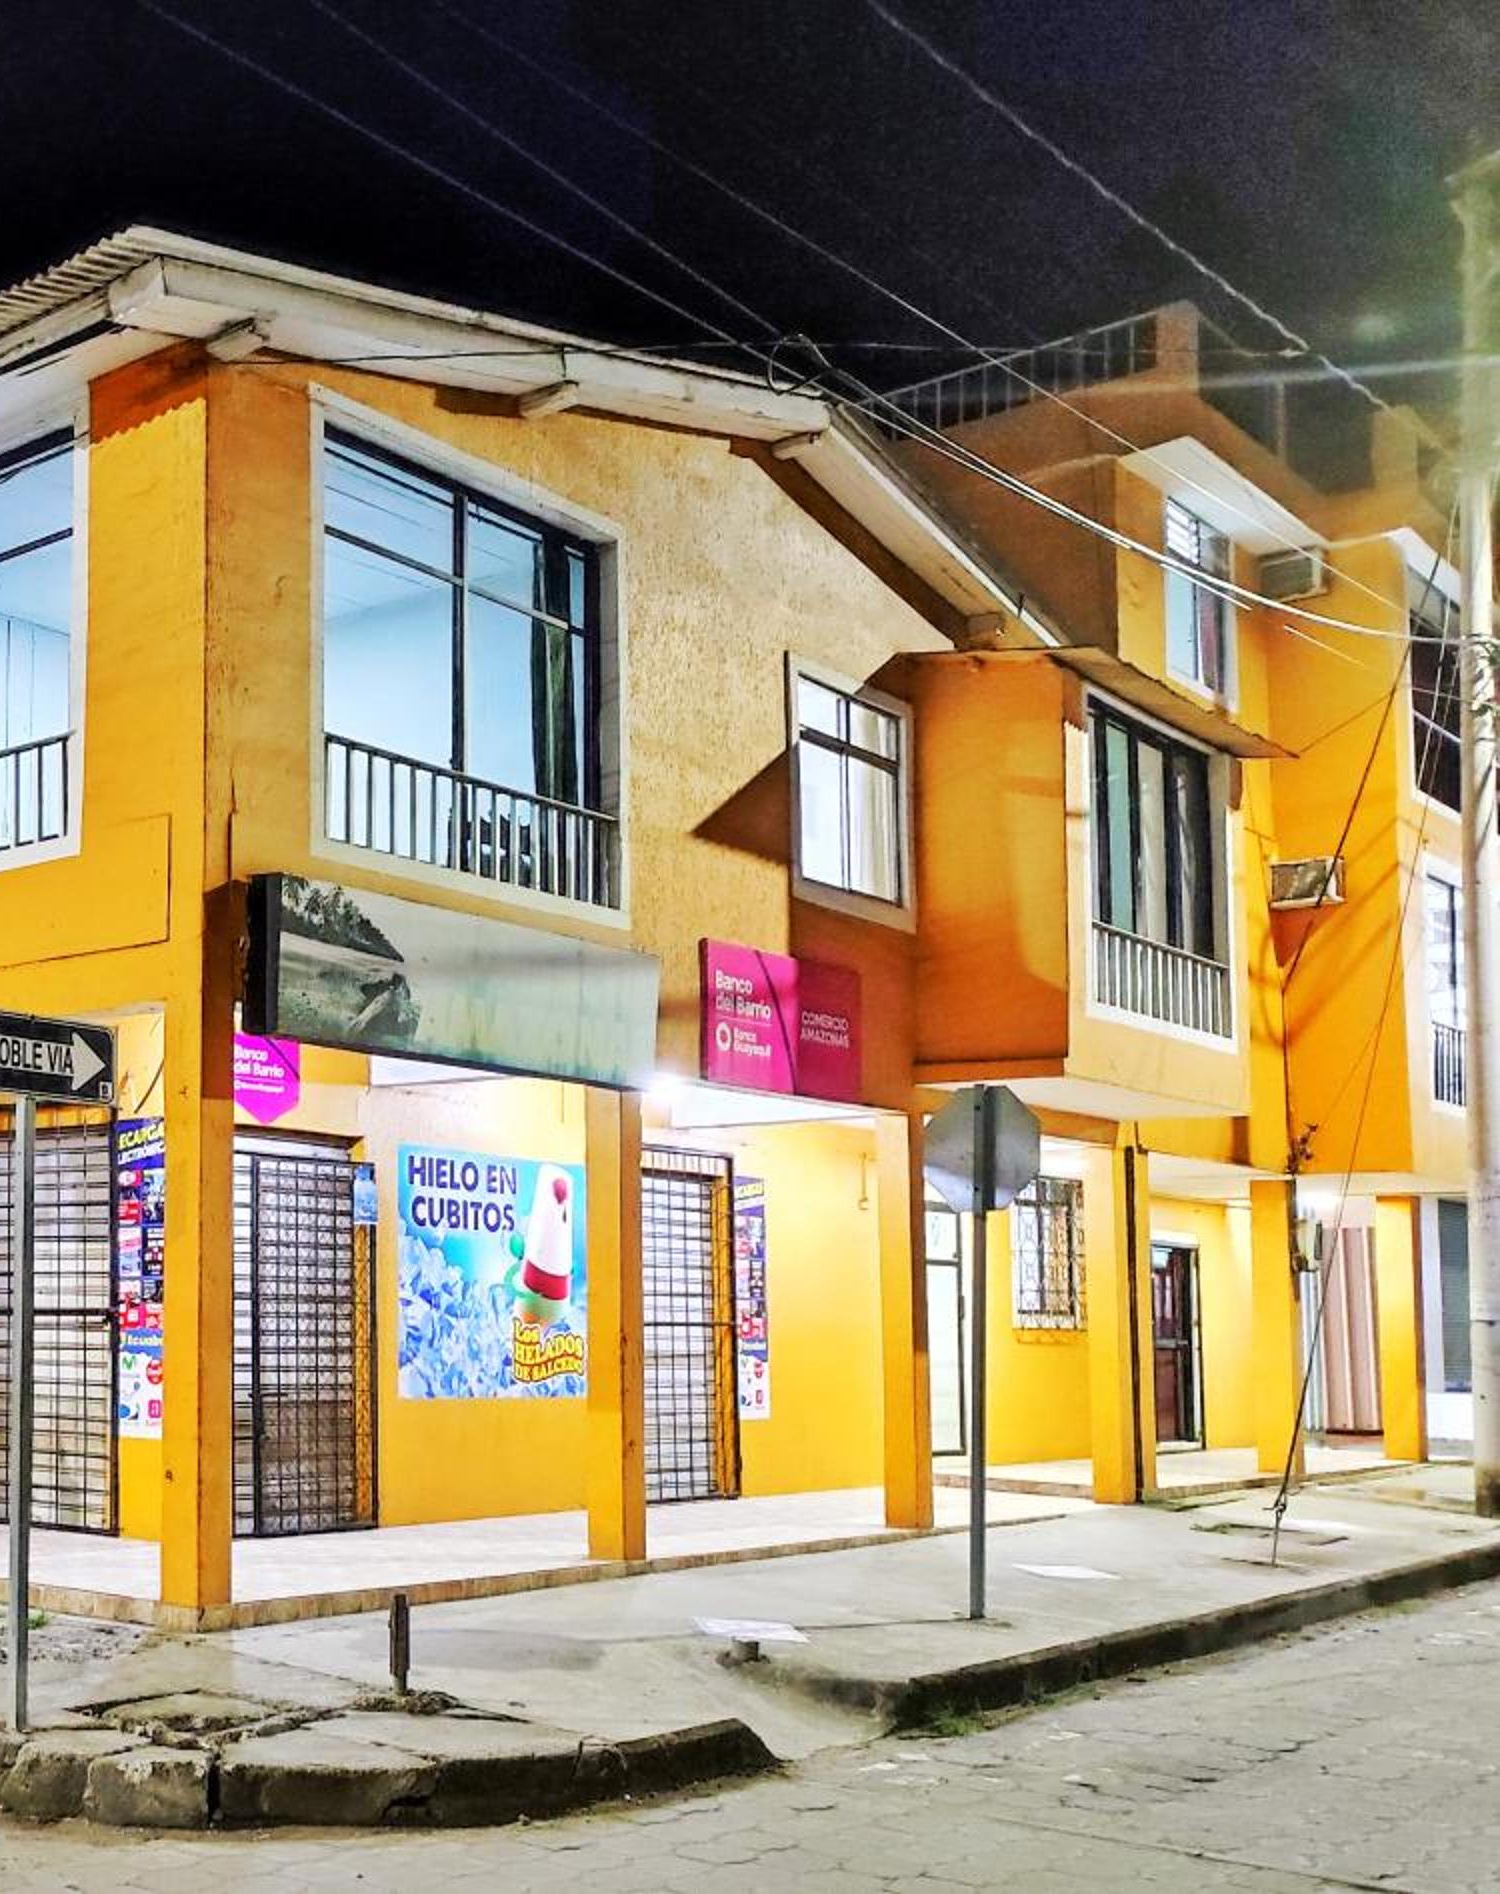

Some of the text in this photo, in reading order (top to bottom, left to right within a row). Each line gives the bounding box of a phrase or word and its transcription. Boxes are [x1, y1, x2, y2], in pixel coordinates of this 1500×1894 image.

[715, 969, 752, 994] Banco
[716, 992, 771, 1021] del Barrio
[801, 1011, 848, 1031] COMERCIO
[800, 1028, 849, 1049] AMAZONAS
[47, 1044, 74, 1074] VIA
[253, 1060, 285, 1079] Barrio
[408, 1155, 516, 1195] HIELO EN
[411, 1195, 515, 1233] CUBITOS
[514, 1332, 584, 1366] HELADOS
[514, 1358, 584, 1382] DE SALCEDO
